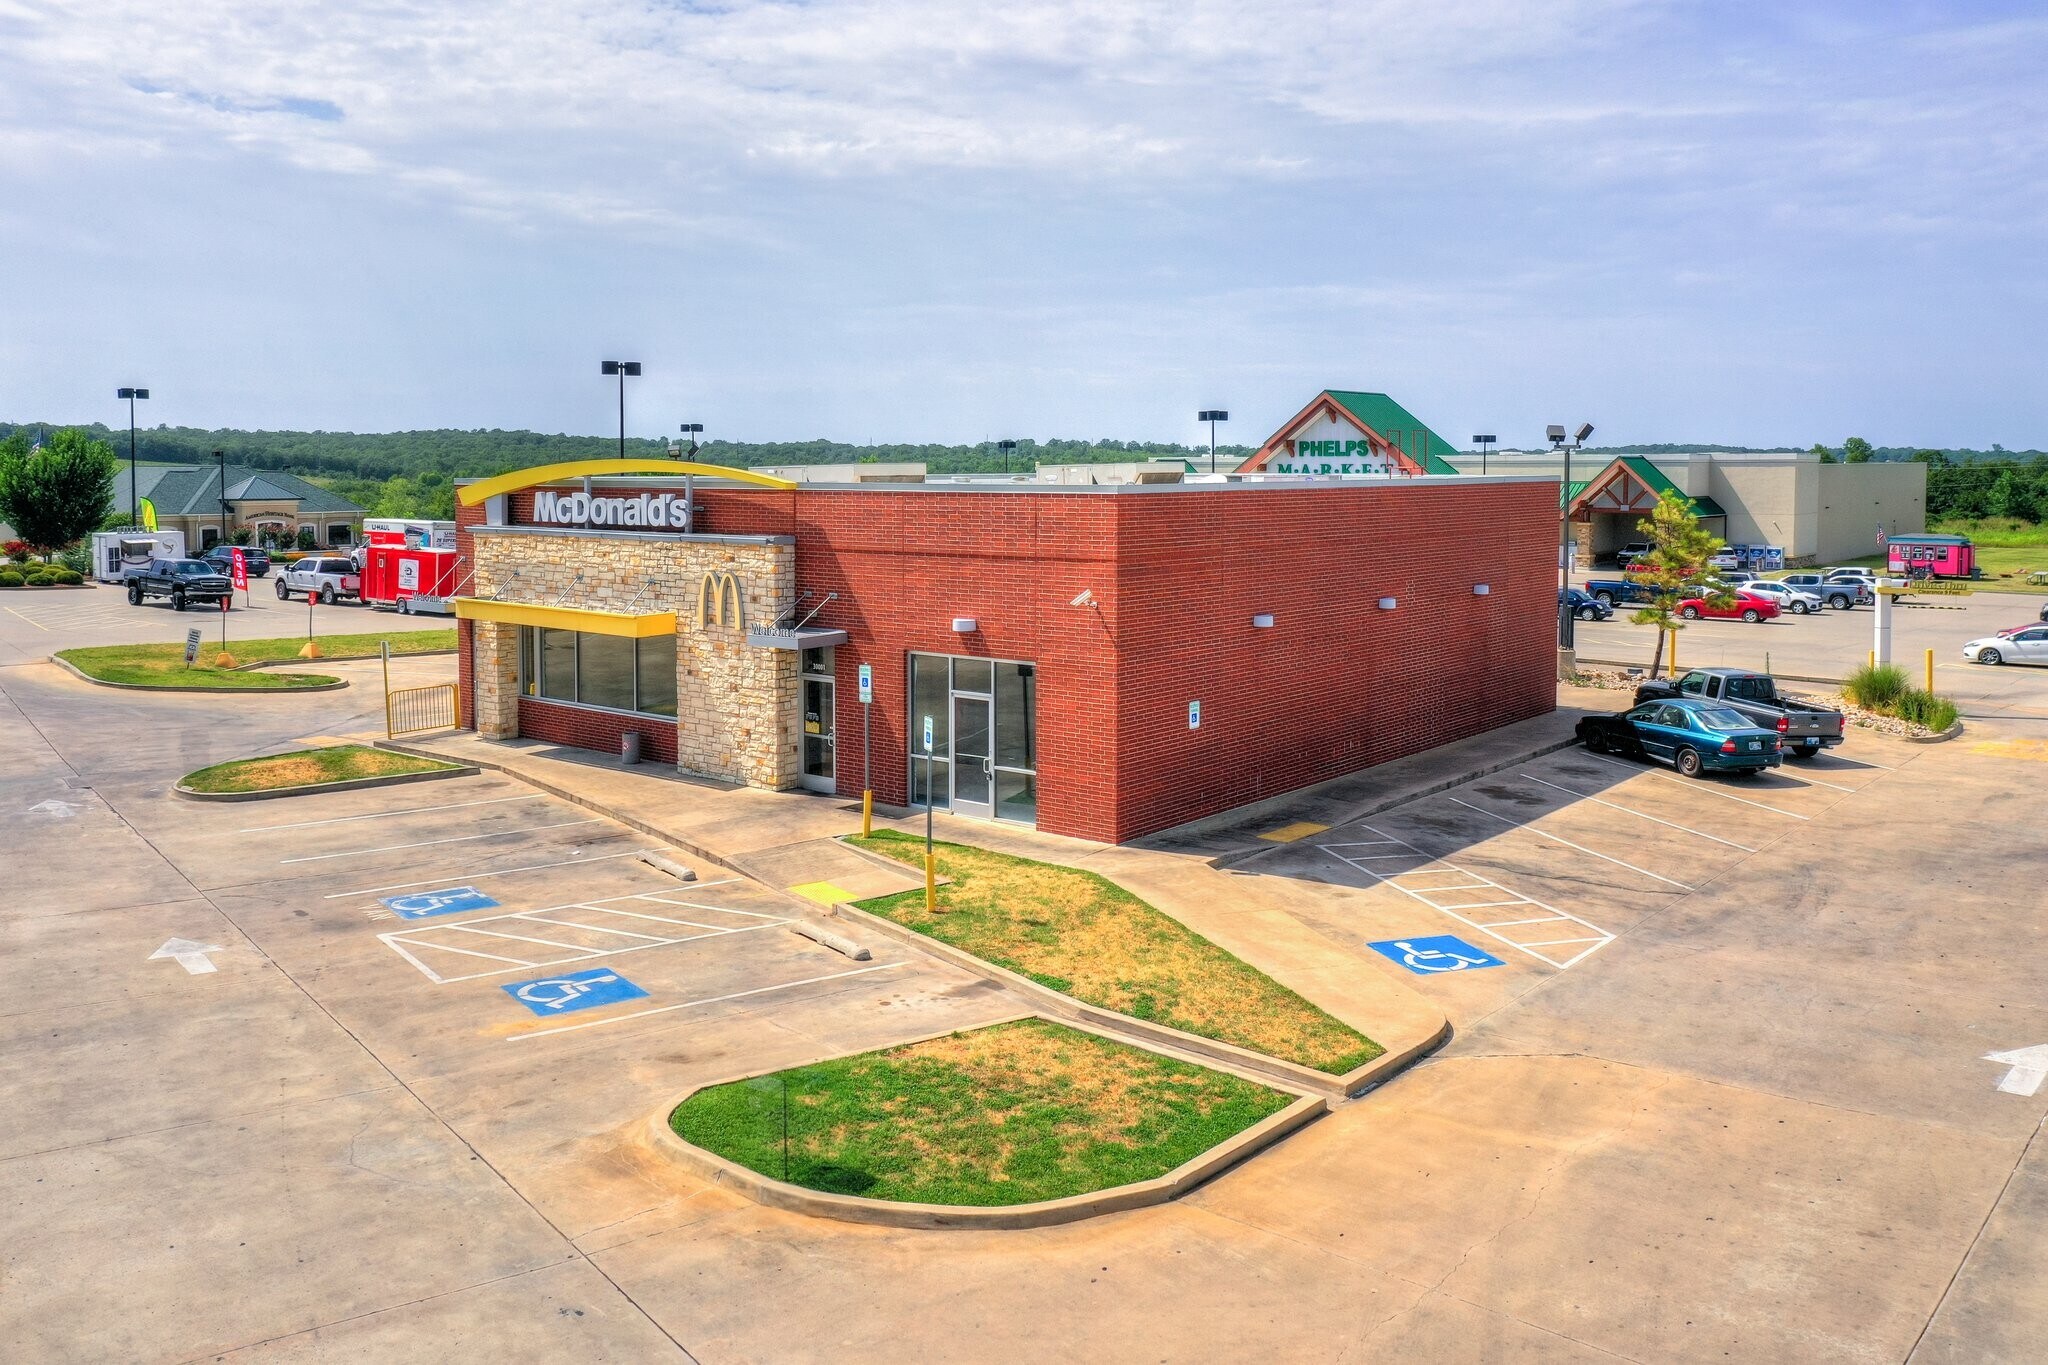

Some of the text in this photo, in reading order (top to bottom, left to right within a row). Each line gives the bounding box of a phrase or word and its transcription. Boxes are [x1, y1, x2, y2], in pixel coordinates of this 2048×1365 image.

[1299, 440, 1369, 457] PHELPS
[533, 491, 688, 528] McDonald's
[751, 623, 796, 638] Welcome
